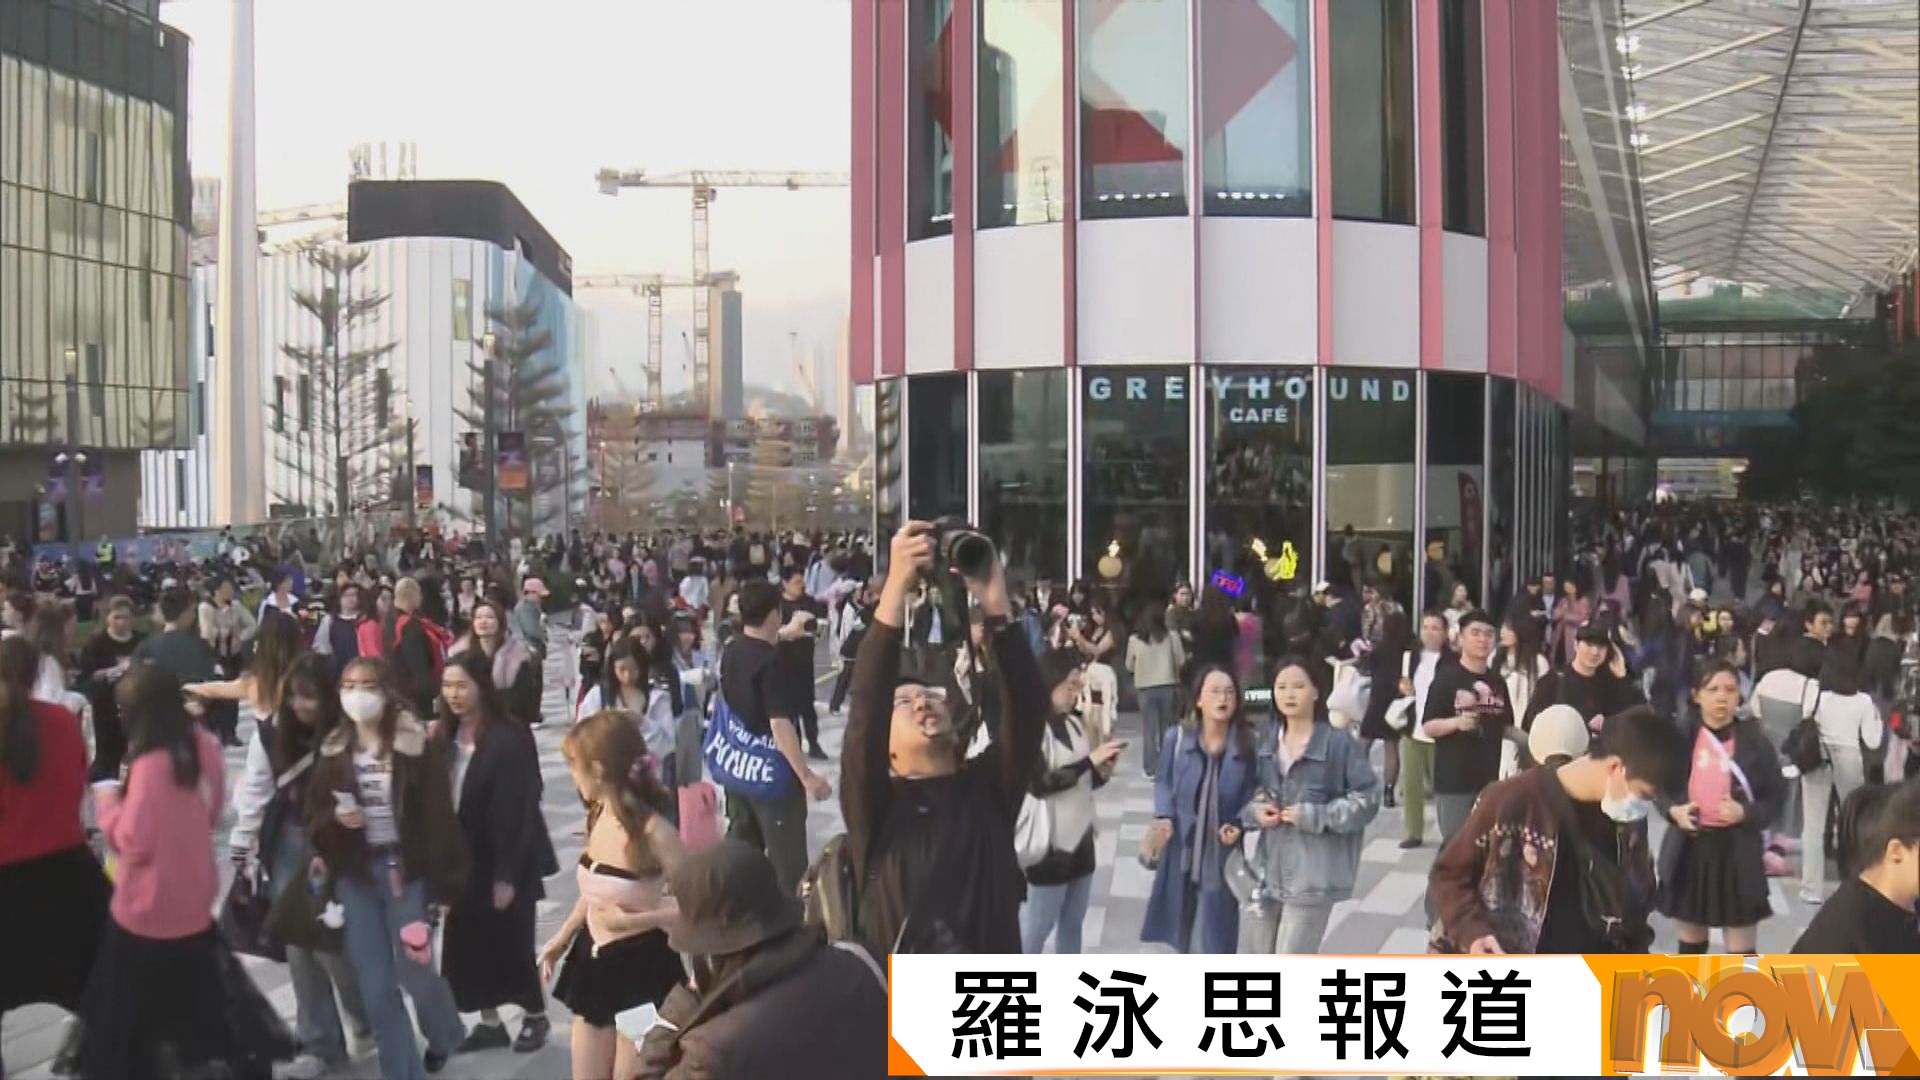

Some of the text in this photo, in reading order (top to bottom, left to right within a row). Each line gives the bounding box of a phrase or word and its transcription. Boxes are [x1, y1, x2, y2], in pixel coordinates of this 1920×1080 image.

[1089, 376, 1411, 401] GREYHOUND
[1229, 407, 1288, 423] CAFÉ
[705, 731, 775, 782] FUTURE
